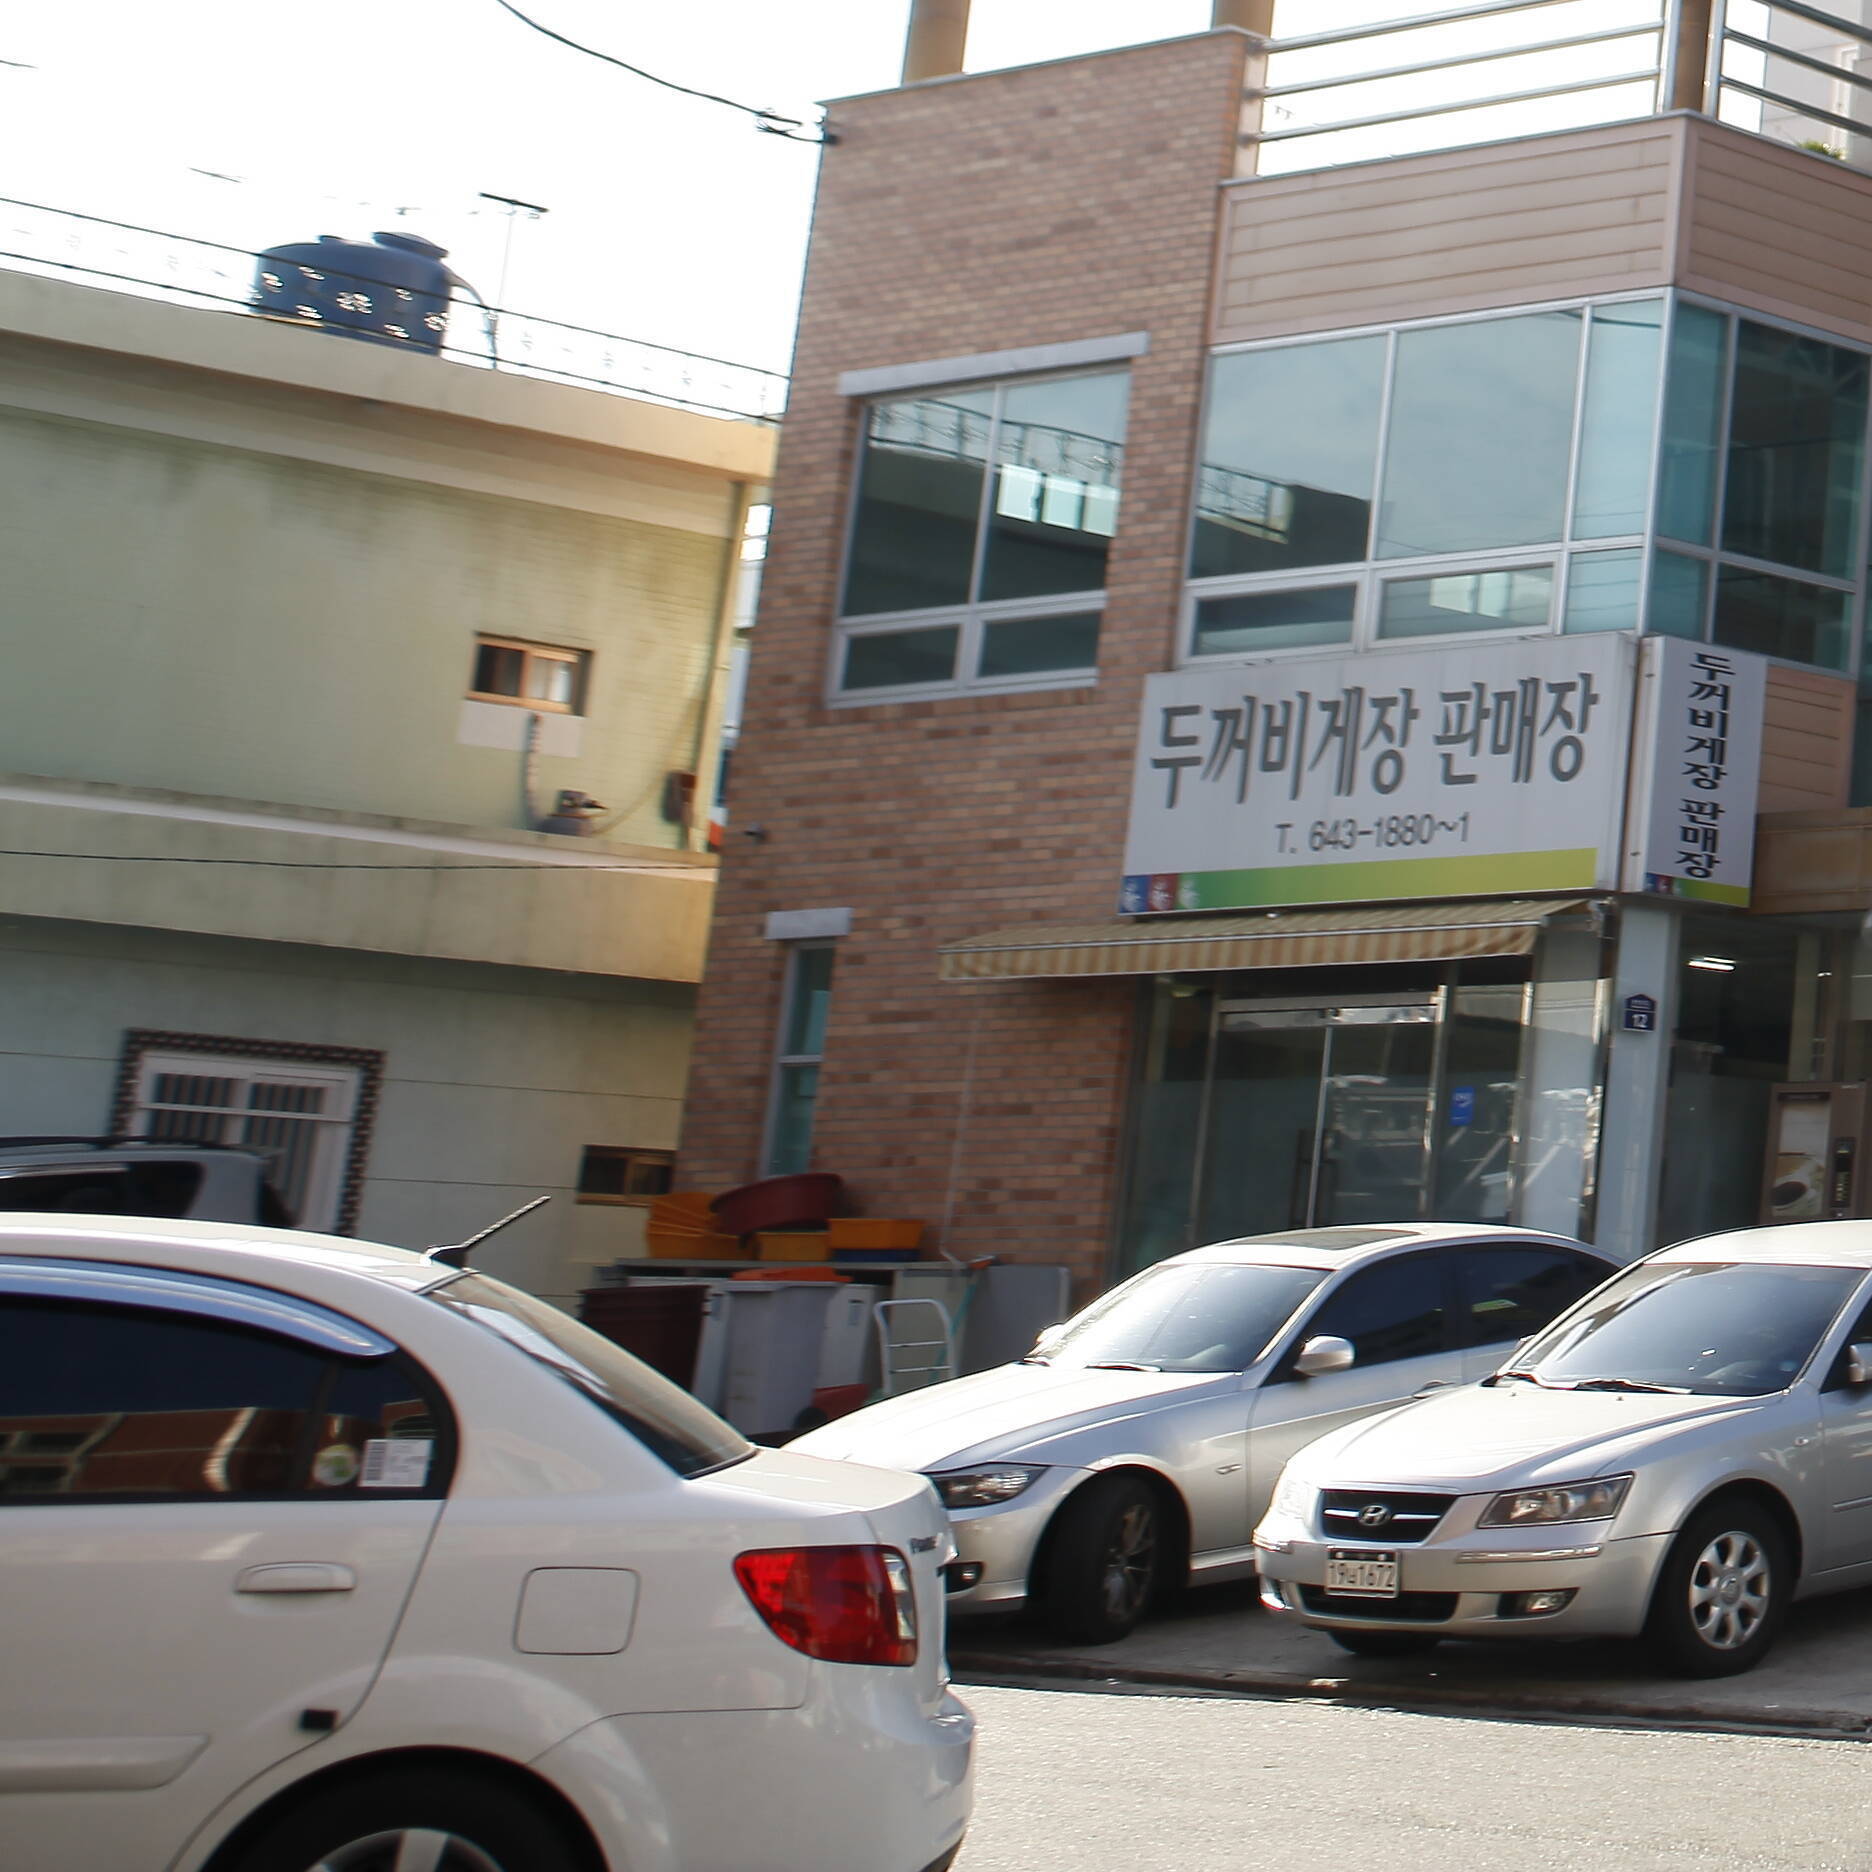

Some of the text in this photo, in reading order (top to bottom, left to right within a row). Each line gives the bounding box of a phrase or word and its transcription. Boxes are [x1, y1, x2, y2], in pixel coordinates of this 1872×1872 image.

[1150, 672, 1600, 810] 두꺼비게장 판매장
[1675, 652, 1736, 878] 두꺼비게장 판매장
[1275, 812, 1470, 854] T. 643-1880~1
